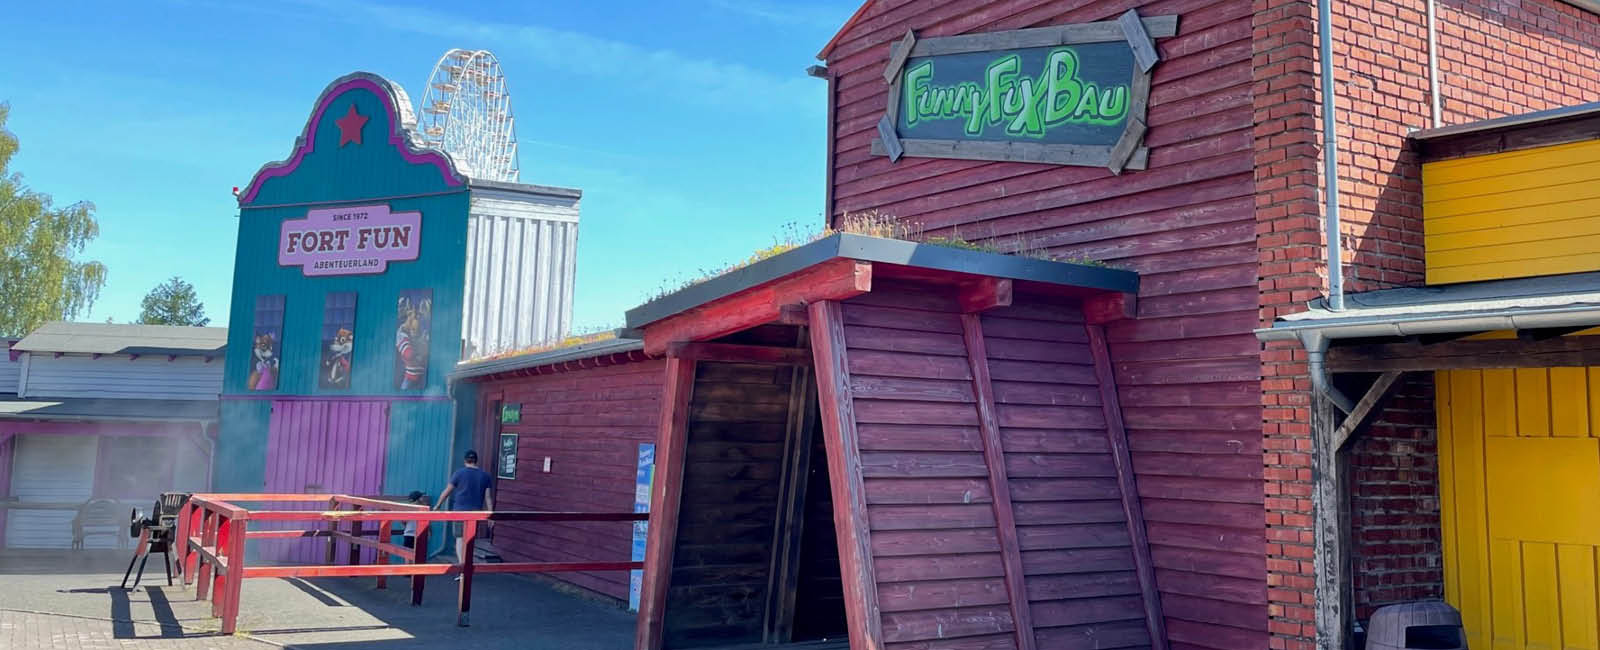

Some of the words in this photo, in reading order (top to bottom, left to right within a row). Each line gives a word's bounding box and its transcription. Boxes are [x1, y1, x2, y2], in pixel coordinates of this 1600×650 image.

[353, 212, 368, 220] 1972
[287, 230, 349, 253] FORT
[357, 226, 411, 249] FUN
[314, 259, 379, 269] ABENTEUERLAND
